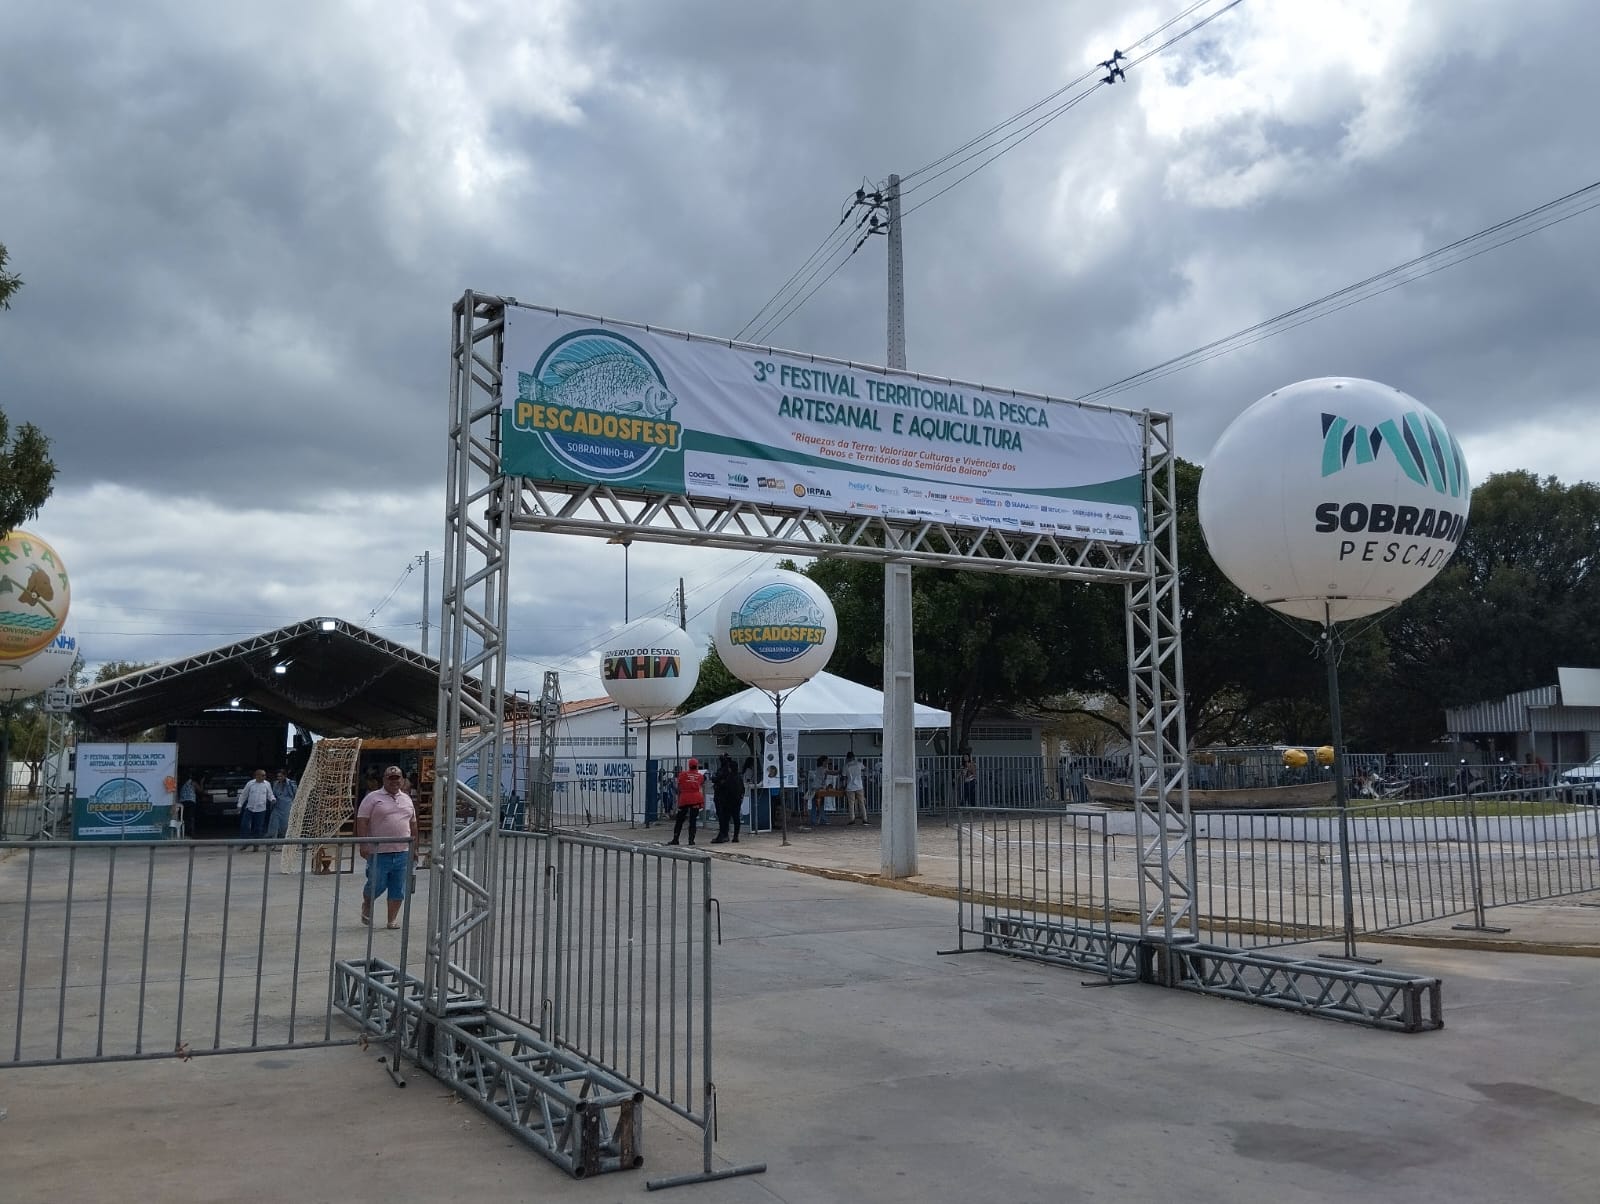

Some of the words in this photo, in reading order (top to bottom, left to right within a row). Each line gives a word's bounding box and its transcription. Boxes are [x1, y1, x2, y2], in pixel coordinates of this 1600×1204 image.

[780, 364, 860, 399] FESTIVAL
[866, 379, 969, 416] TERRITORIAL
[973, 396, 995, 420] DA
[999, 401, 1049, 428] PESCA
[517, 402, 678, 447] PESCADOSFEST
[778, 394, 882, 432] ARTESANAL
[892, 412, 904, 435] E
[908, 415, 1023, 451] AQUICULTURA
[567, 442, 635, 459] SOBRADINHO-BA
[820, 446, 846, 458] Povos
[856, 451, 900, 466] Territórios
[902, 458, 913, 468] do
[915, 459, 957, 473] Semiárido
[837, 439, 849, 448] da
[851, 440, 878, 453] Terra:
[880, 445, 918, 458] Valorizar
[920, 450, 954, 463] Culturas
[963, 456, 1000, 470] Vivências
[1002, 461, 1016, 472] dos
[806, 488, 832, 497] IRPAA
[731, 626, 826, 644] PESCADOSFEST
[636, 648, 648, 656] DO
[651, 648, 680, 656] ESTADO
[604, 656, 680, 680] BAHIA
